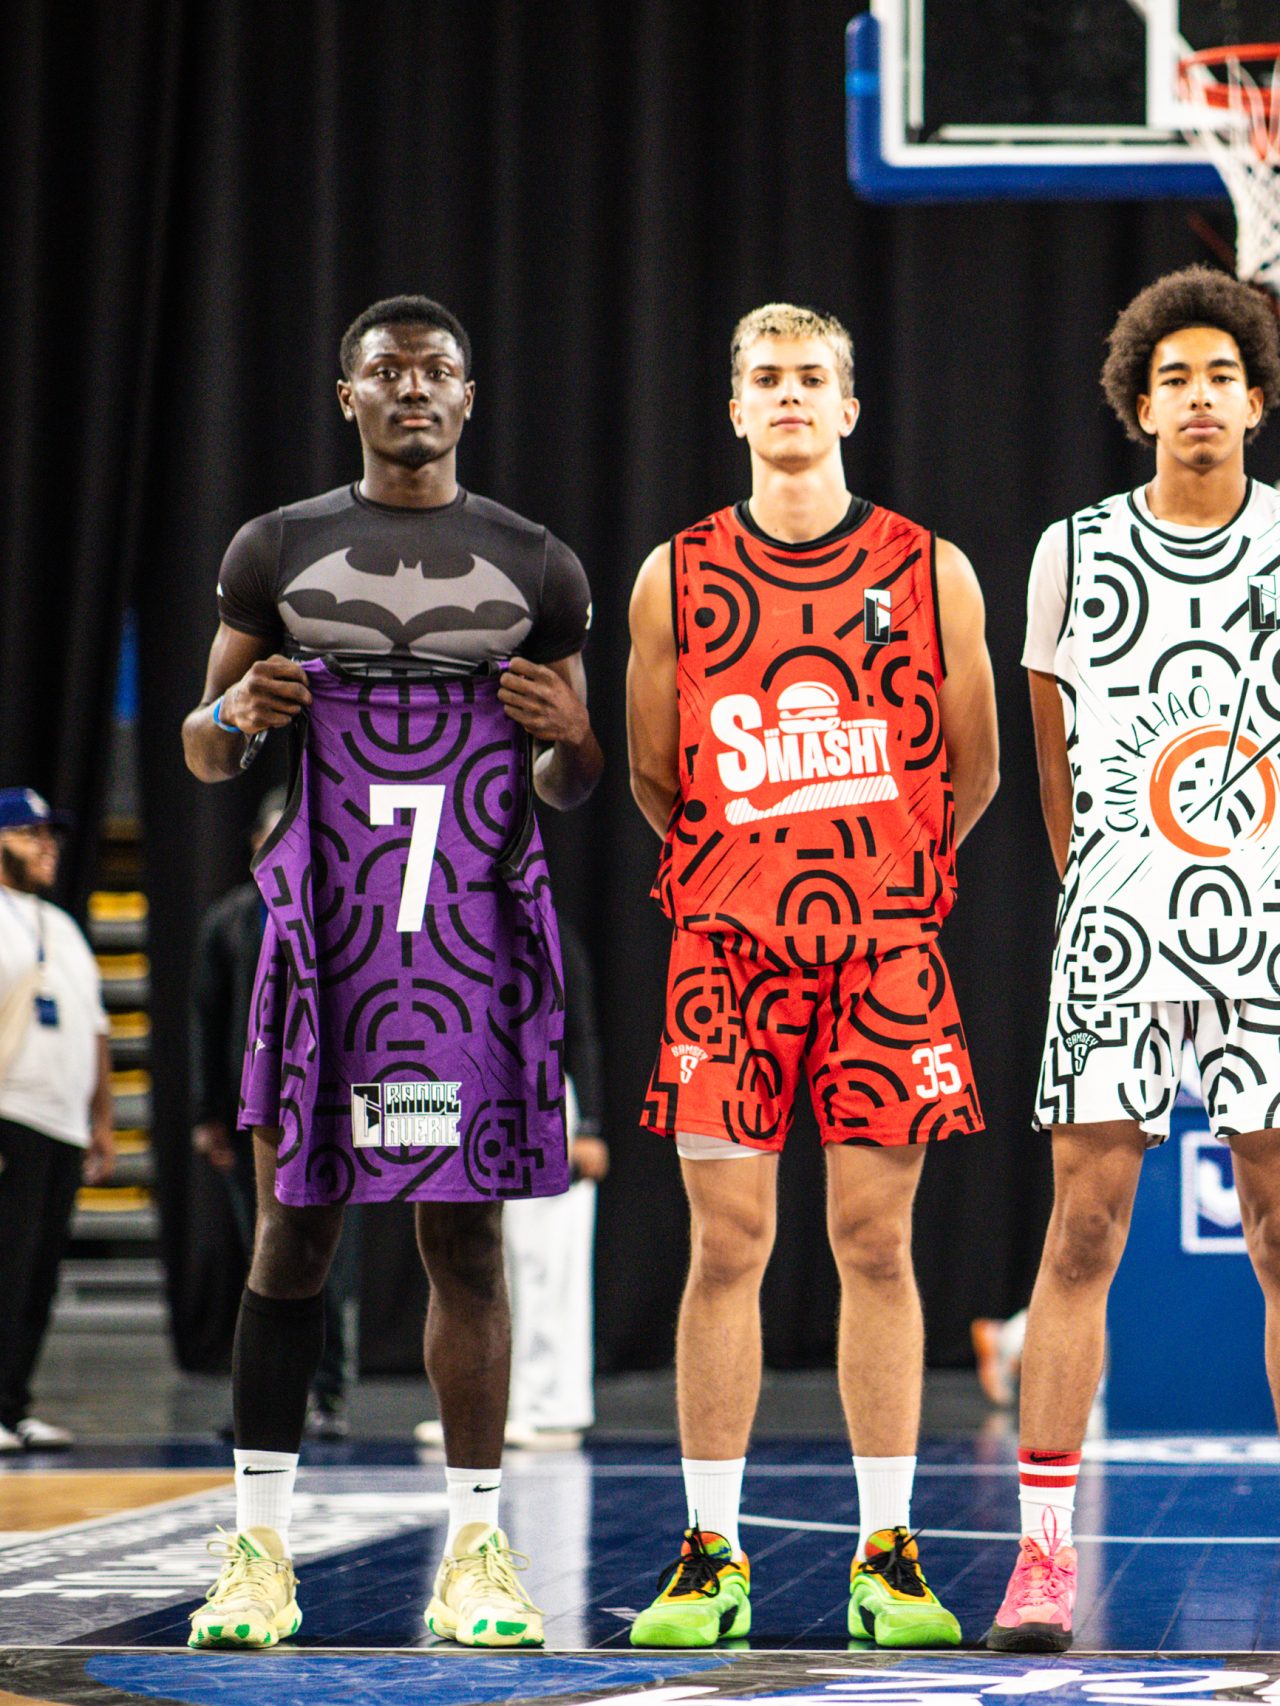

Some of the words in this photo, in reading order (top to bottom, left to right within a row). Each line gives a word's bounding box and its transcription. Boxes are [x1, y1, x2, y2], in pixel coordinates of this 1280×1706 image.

[710, 693, 892, 792] SMASHY
[1115, 684, 1211, 758] KHAO
[369, 784, 446, 932] 7
[912, 1043, 962, 1099] 35
[1065, 1032, 1099, 1048] SAMSEY
